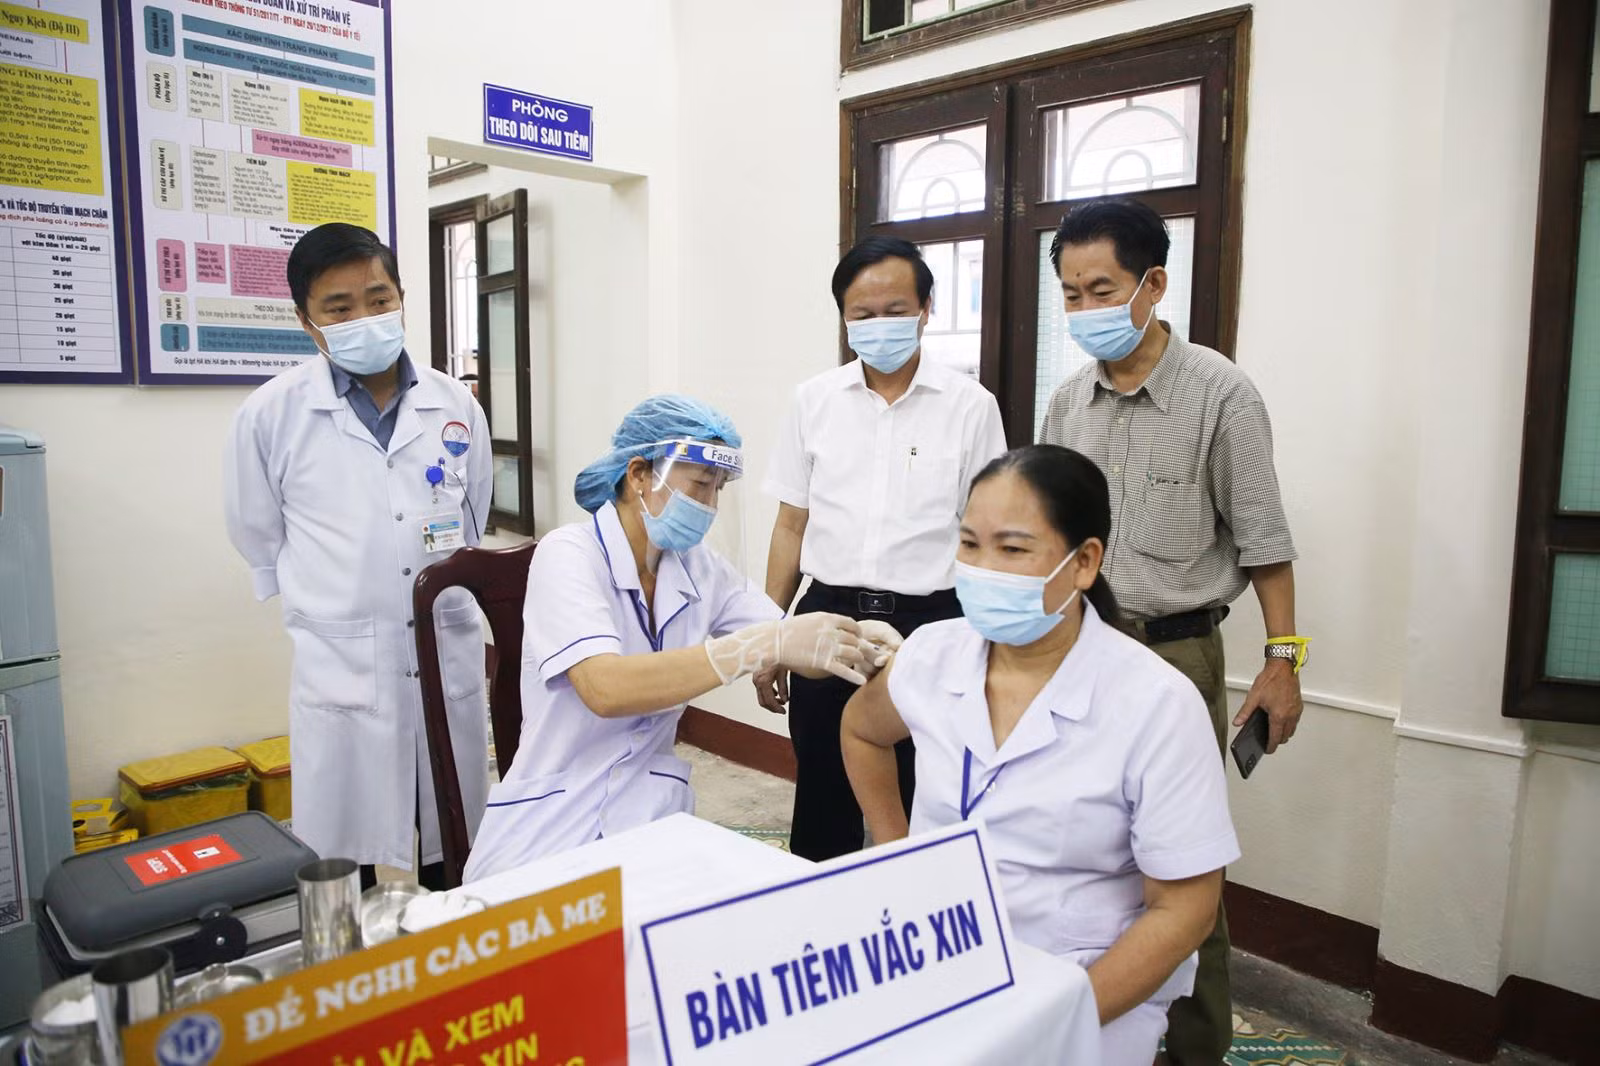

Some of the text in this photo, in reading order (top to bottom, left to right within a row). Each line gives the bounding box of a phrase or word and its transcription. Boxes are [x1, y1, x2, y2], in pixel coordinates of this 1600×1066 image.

[2, 10, 24, 26] Nguy
[27, 15, 46, 29] Kịch
[512, 98, 569, 122] PHÒNG
[489, 116, 589, 153] THEO DÕI SAU TIÊM
[712, 450, 732, 464] Face
[314, 956, 417, 1017] NGHỊ
[425, 928, 501, 976] CÁC
[562, 892, 607, 930] MẸ
[685, 900, 984, 1050] BÀN TIÊM VẮC XIN
[379, 994, 525, 1066] VÀ XEM
[480, 1032, 538, 1066] XIN
